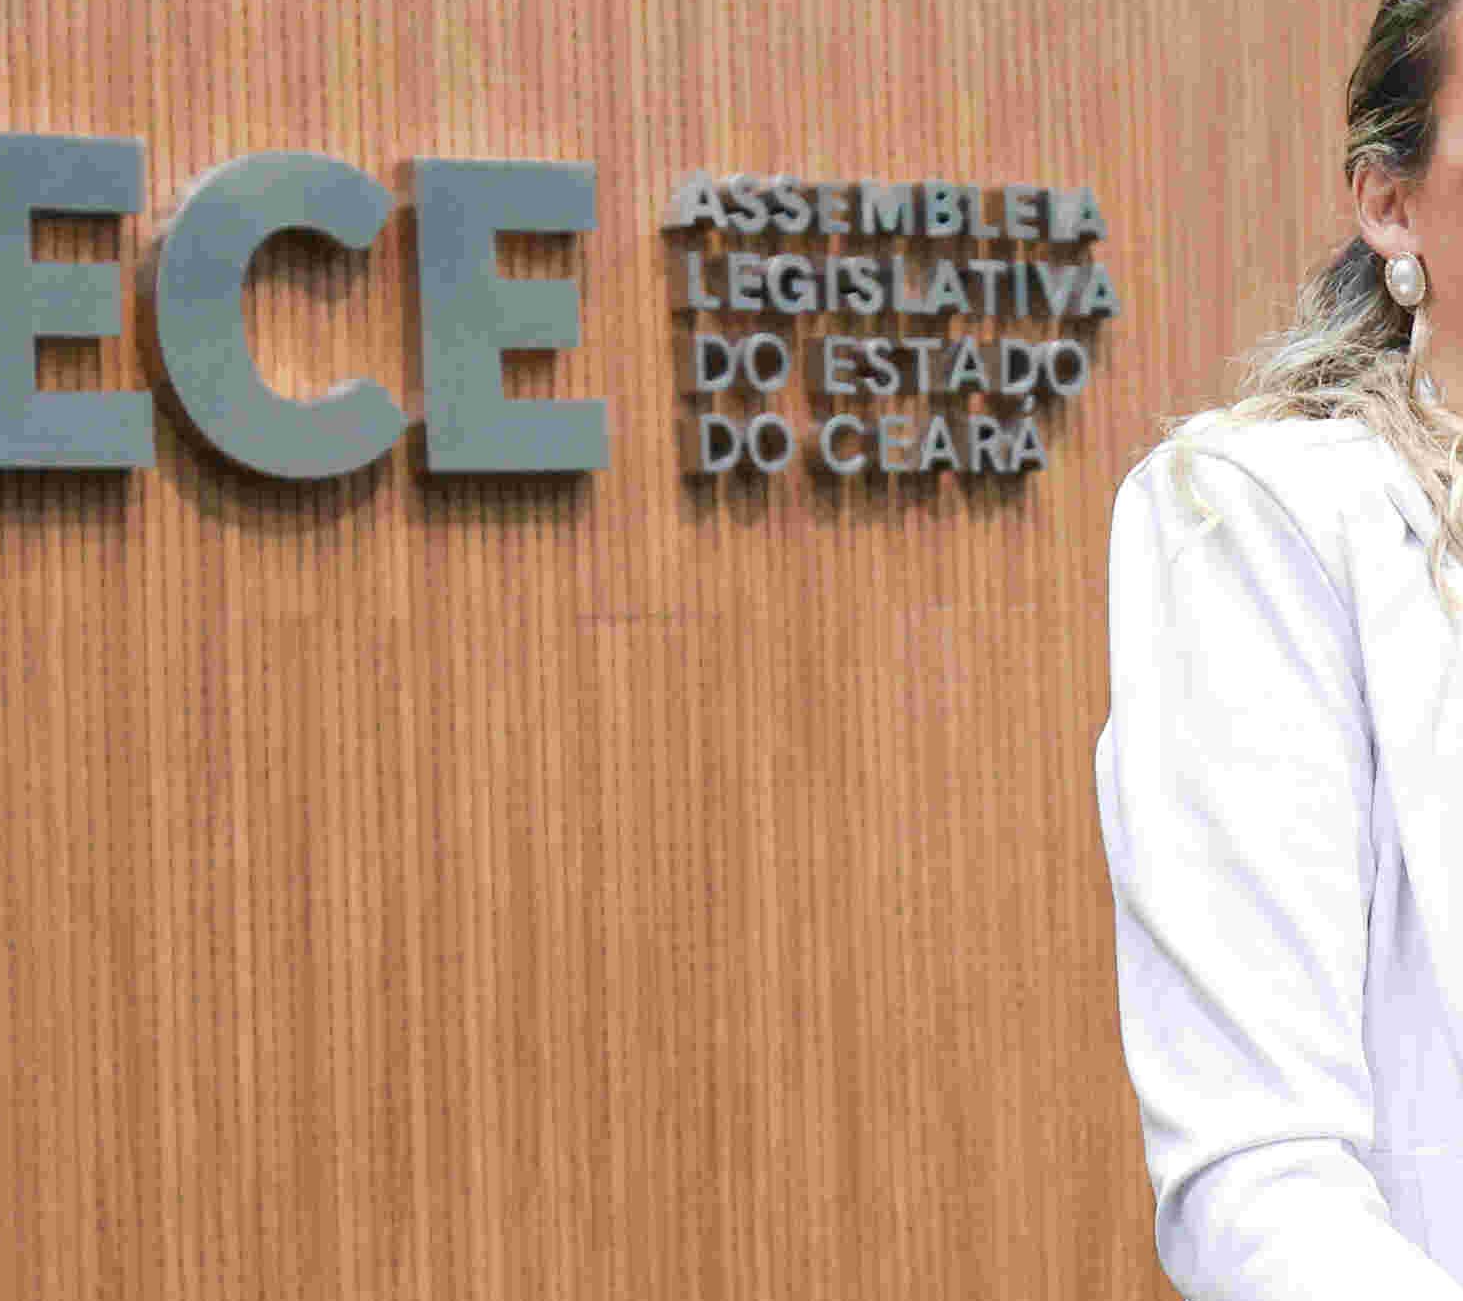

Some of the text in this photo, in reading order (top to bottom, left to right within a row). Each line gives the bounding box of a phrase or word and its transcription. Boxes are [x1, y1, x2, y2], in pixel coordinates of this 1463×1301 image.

[663, 169, 1107, 243] ASSEMBLEIA
[686, 250, 1121, 318] LEGISLATIVA
[695, 332, 1091, 397] DO ESTADO
[698, 396, 1048, 476] DO CEARÁ
